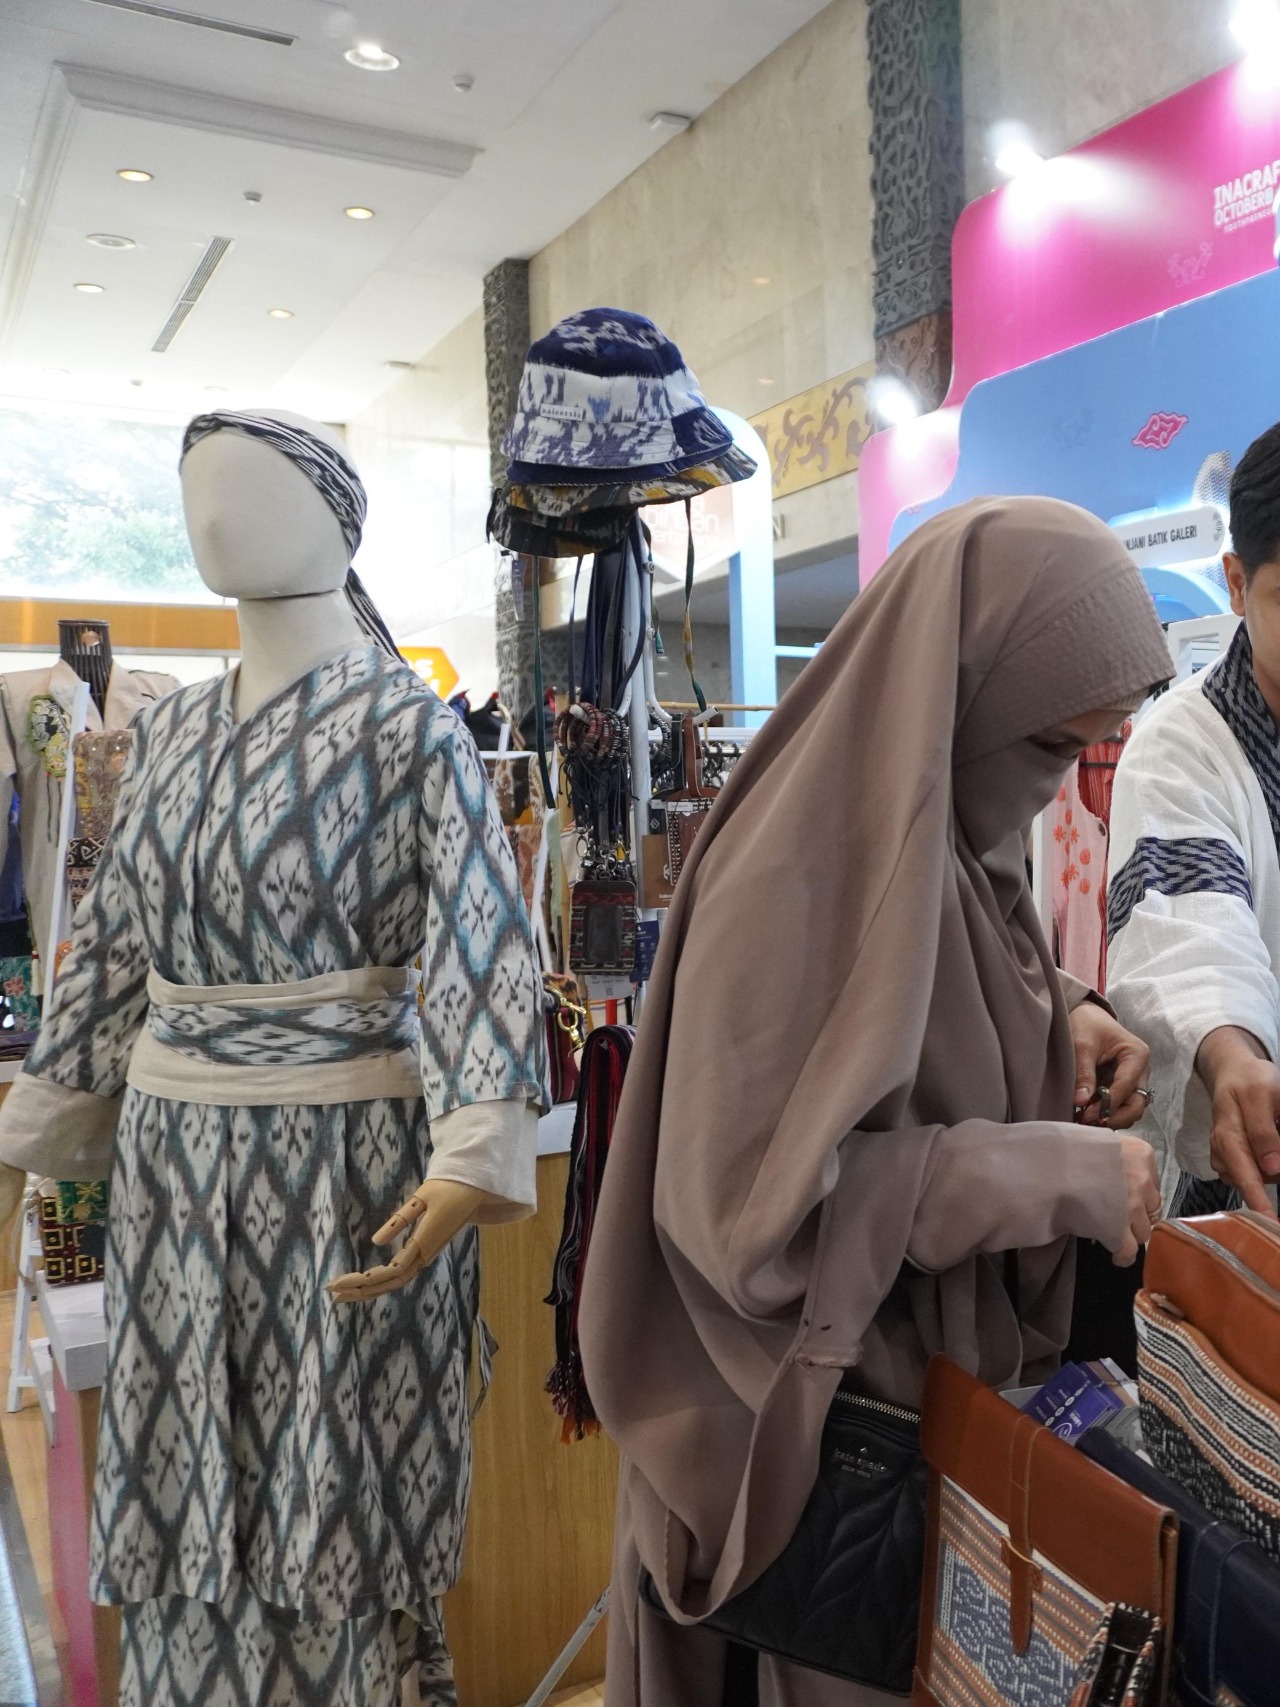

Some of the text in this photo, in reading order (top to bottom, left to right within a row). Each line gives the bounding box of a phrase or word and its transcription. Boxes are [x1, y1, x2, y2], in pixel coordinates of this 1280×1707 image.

[1214, 190, 1266, 226] OCTOBER
[1122, 525, 1198, 551] NJANI BATIK GALERI
